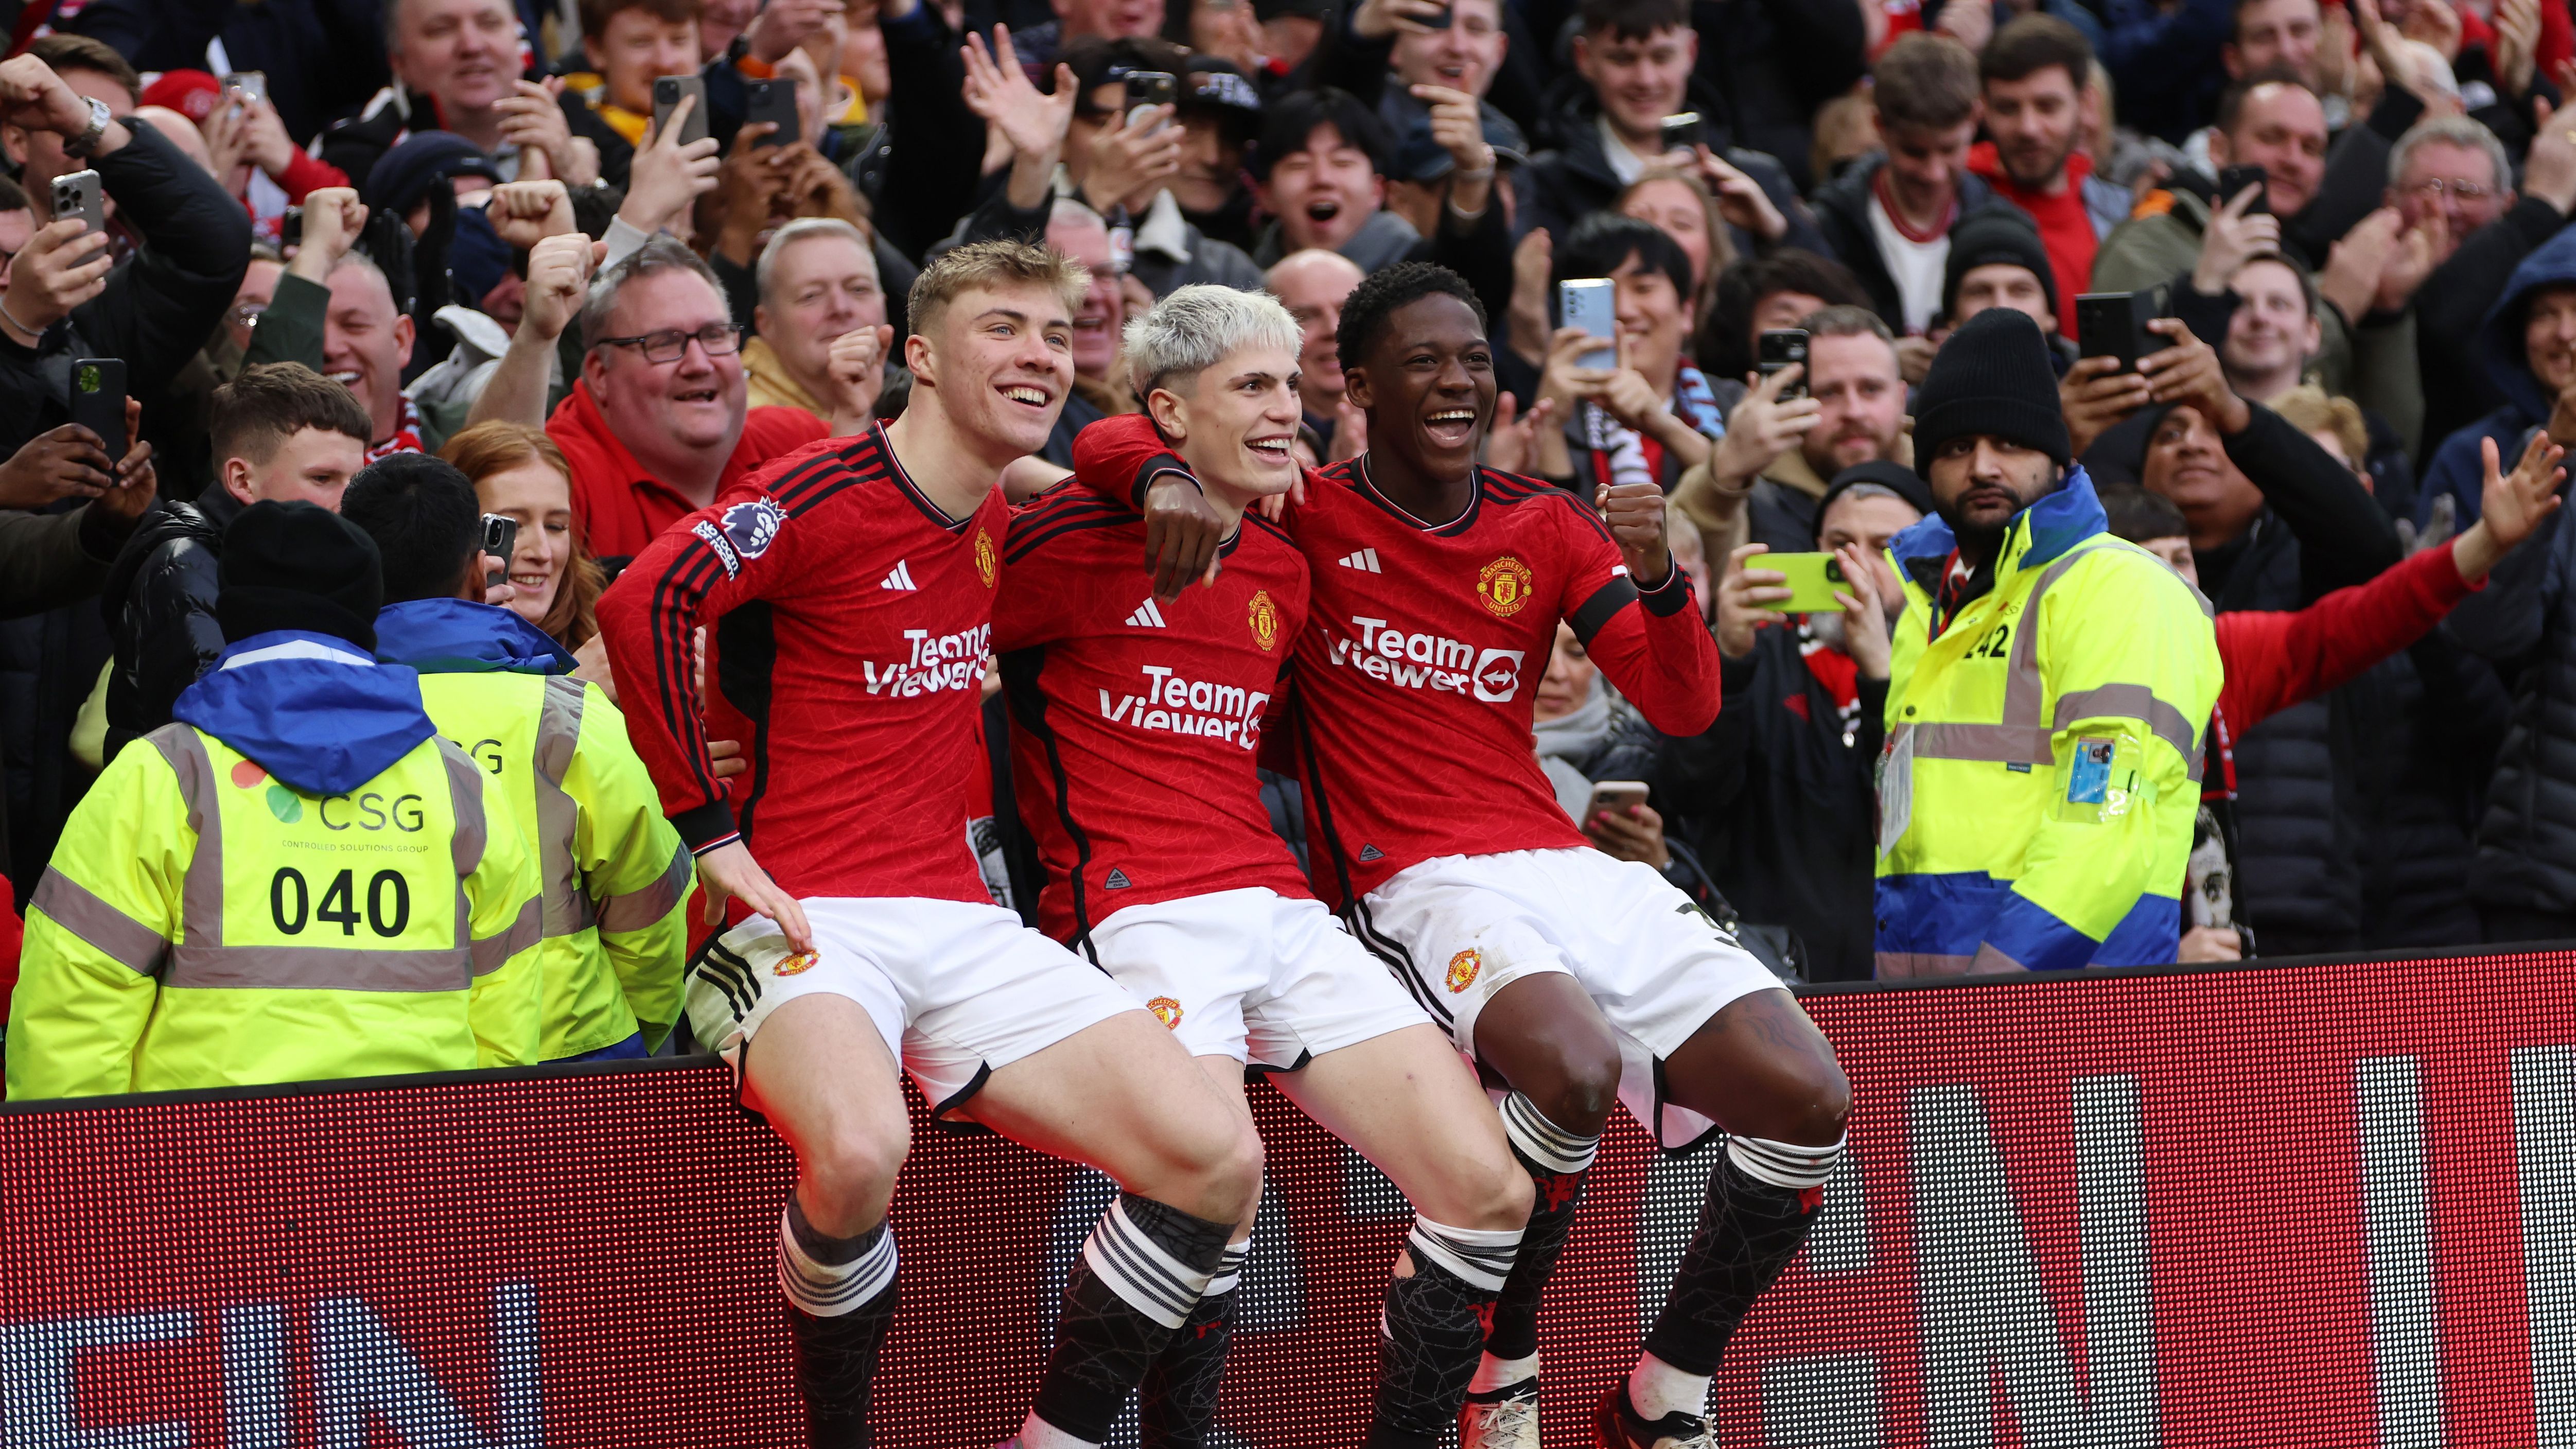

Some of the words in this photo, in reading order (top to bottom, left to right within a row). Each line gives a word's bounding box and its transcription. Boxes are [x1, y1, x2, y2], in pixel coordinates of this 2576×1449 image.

[698, 520, 718, 536] No
[716, 534, 739, 571] room
[709, 538, 735, 582] racism
[1484, 561, 1528, 581] MANCHESTER
[1488, 601, 1519, 613] UNITED
[903, 625, 979, 669] Team
[1257, 636, 1274, 647] UNITED
[1319, 627, 1470, 695] Viewer
[1352, 615, 1475, 671] Team
[863, 659, 977, 697] Viewer
[1142, 665, 1246, 718] Team
[1098, 688, 1240, 742] Viewer
[320, 792, 424, 832] CSG
[282, 840, 337, 851] CONTROLLED
[340, 844, 394, 852] SOLUTIONS
[269, 866, 411, 938] 040
[785, 963, 812, 975] UNITED
[1448, 952, 1473, 982] MANCHESTER
[1460, 968, 1478, 990] UNITED
